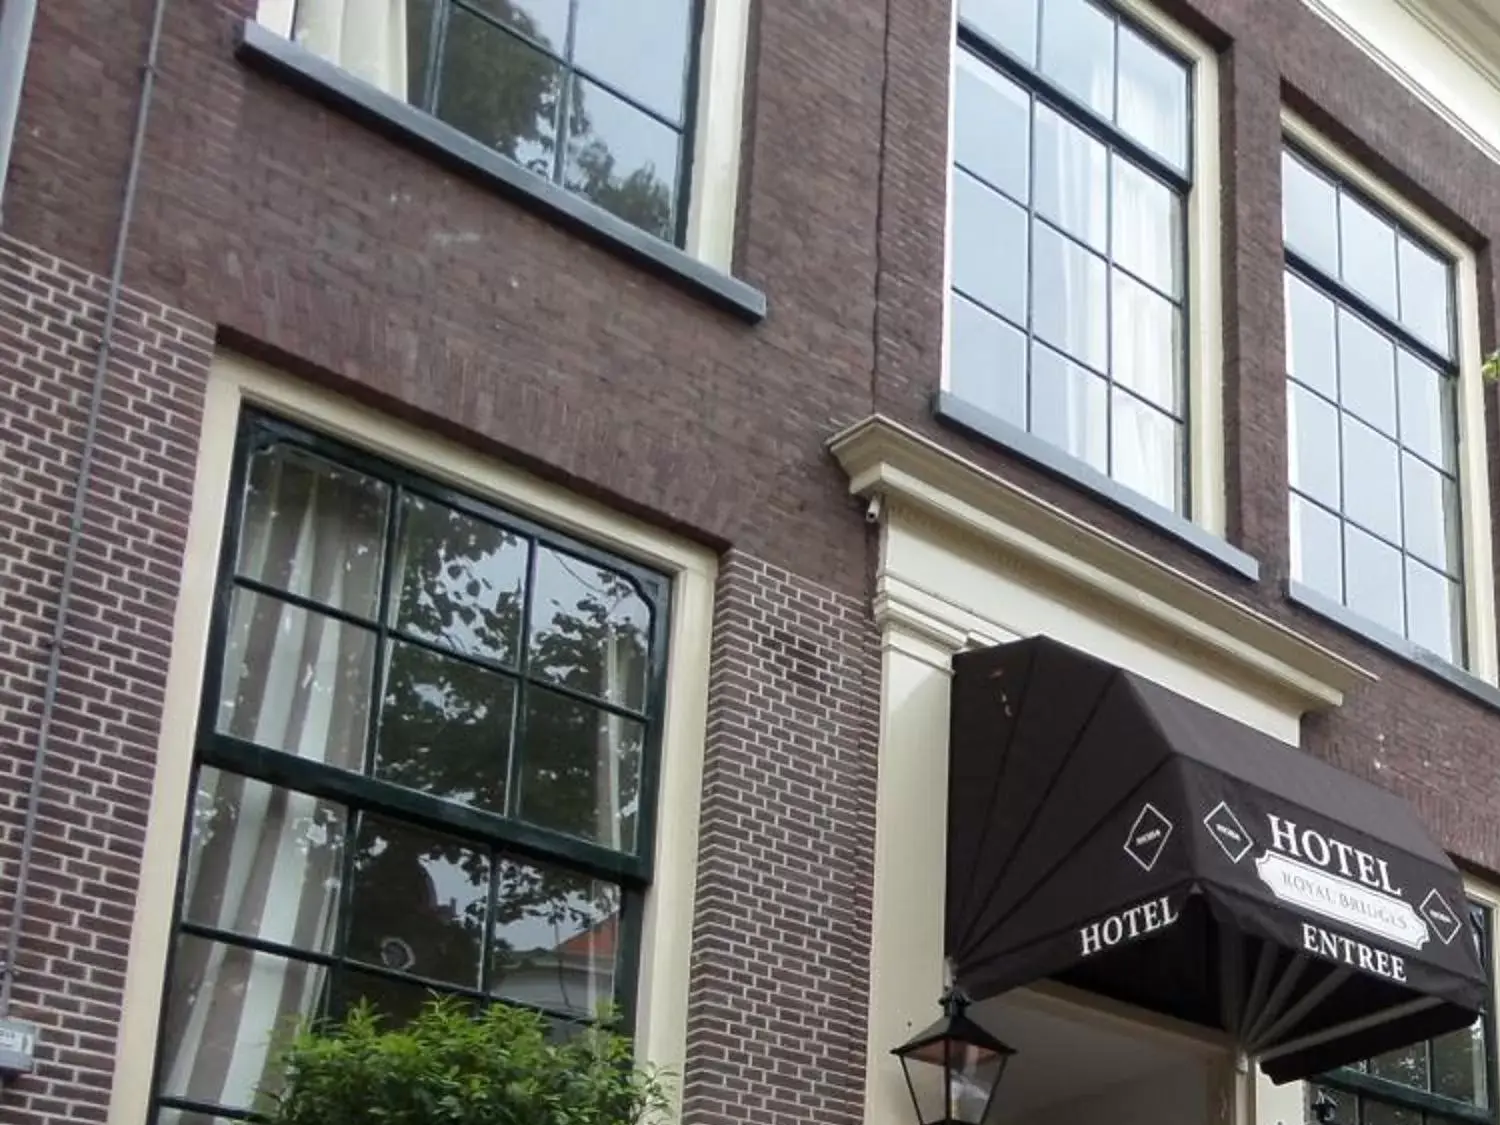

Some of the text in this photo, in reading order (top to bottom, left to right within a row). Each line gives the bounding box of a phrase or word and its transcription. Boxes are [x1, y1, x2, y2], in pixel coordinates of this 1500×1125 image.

[1266, 813, 1402, 896] HOTEL
[1281, 870, 1333, 903] ROYAL
[1080, 896, 1179, 956] HOTEL
[1302, 923, 1407, 982] ENTREE
